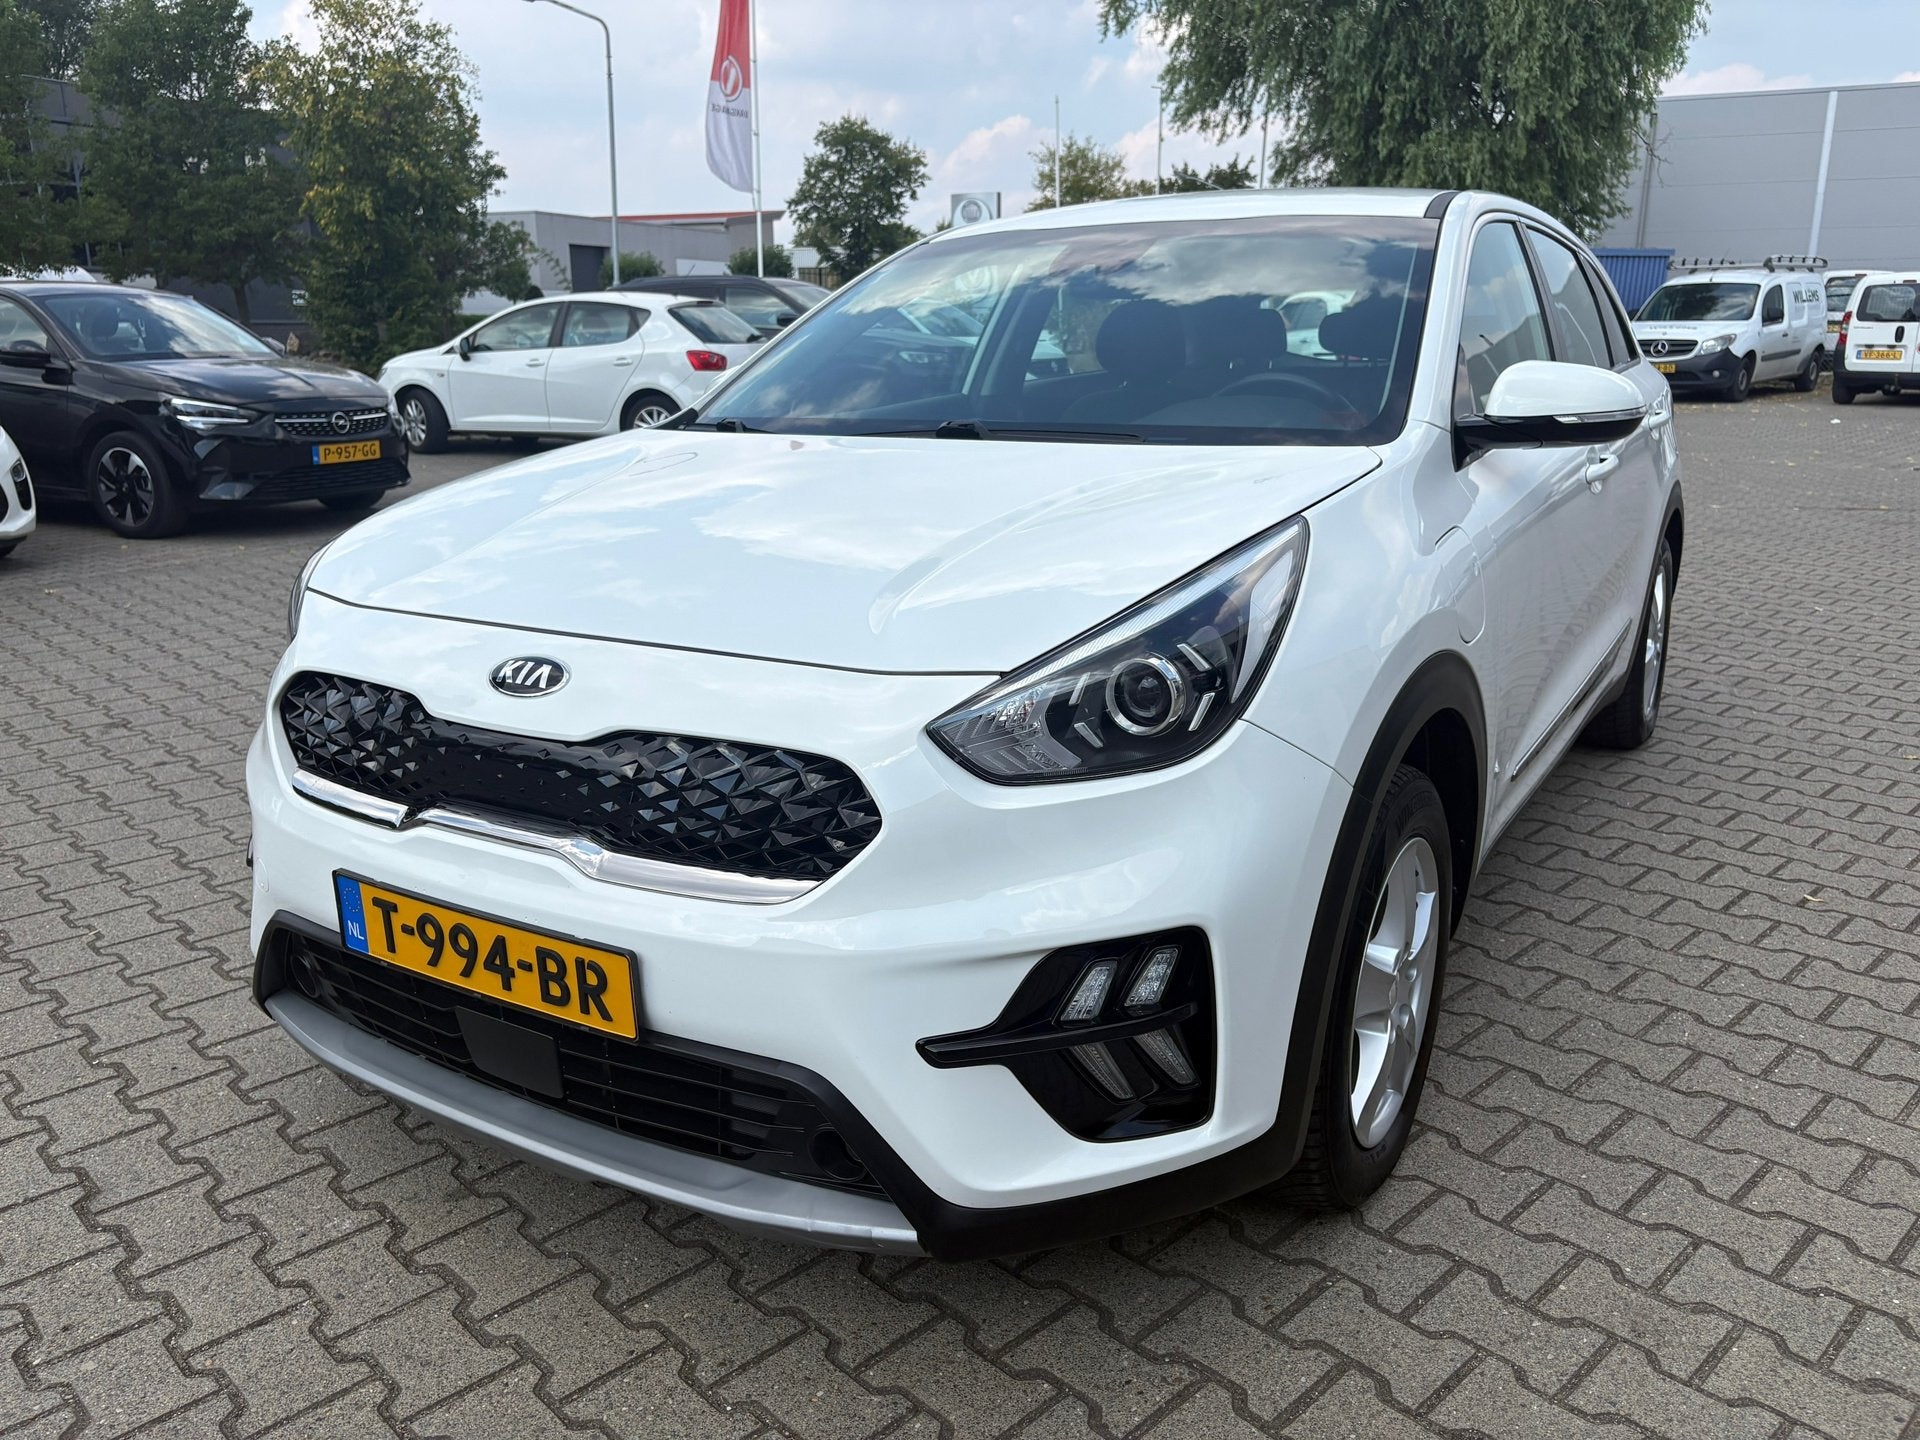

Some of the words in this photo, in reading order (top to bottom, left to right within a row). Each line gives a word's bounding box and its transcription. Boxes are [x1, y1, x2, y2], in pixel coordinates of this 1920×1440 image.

[1792, 288, 1820, 304] WILLEMS
[323, 443, 377, 461] P-957-GG
[496, 660, 552, 689] KIA
[347, 919, 365, 940] NL
[371, 896, 613, 1022] T-994-BR
